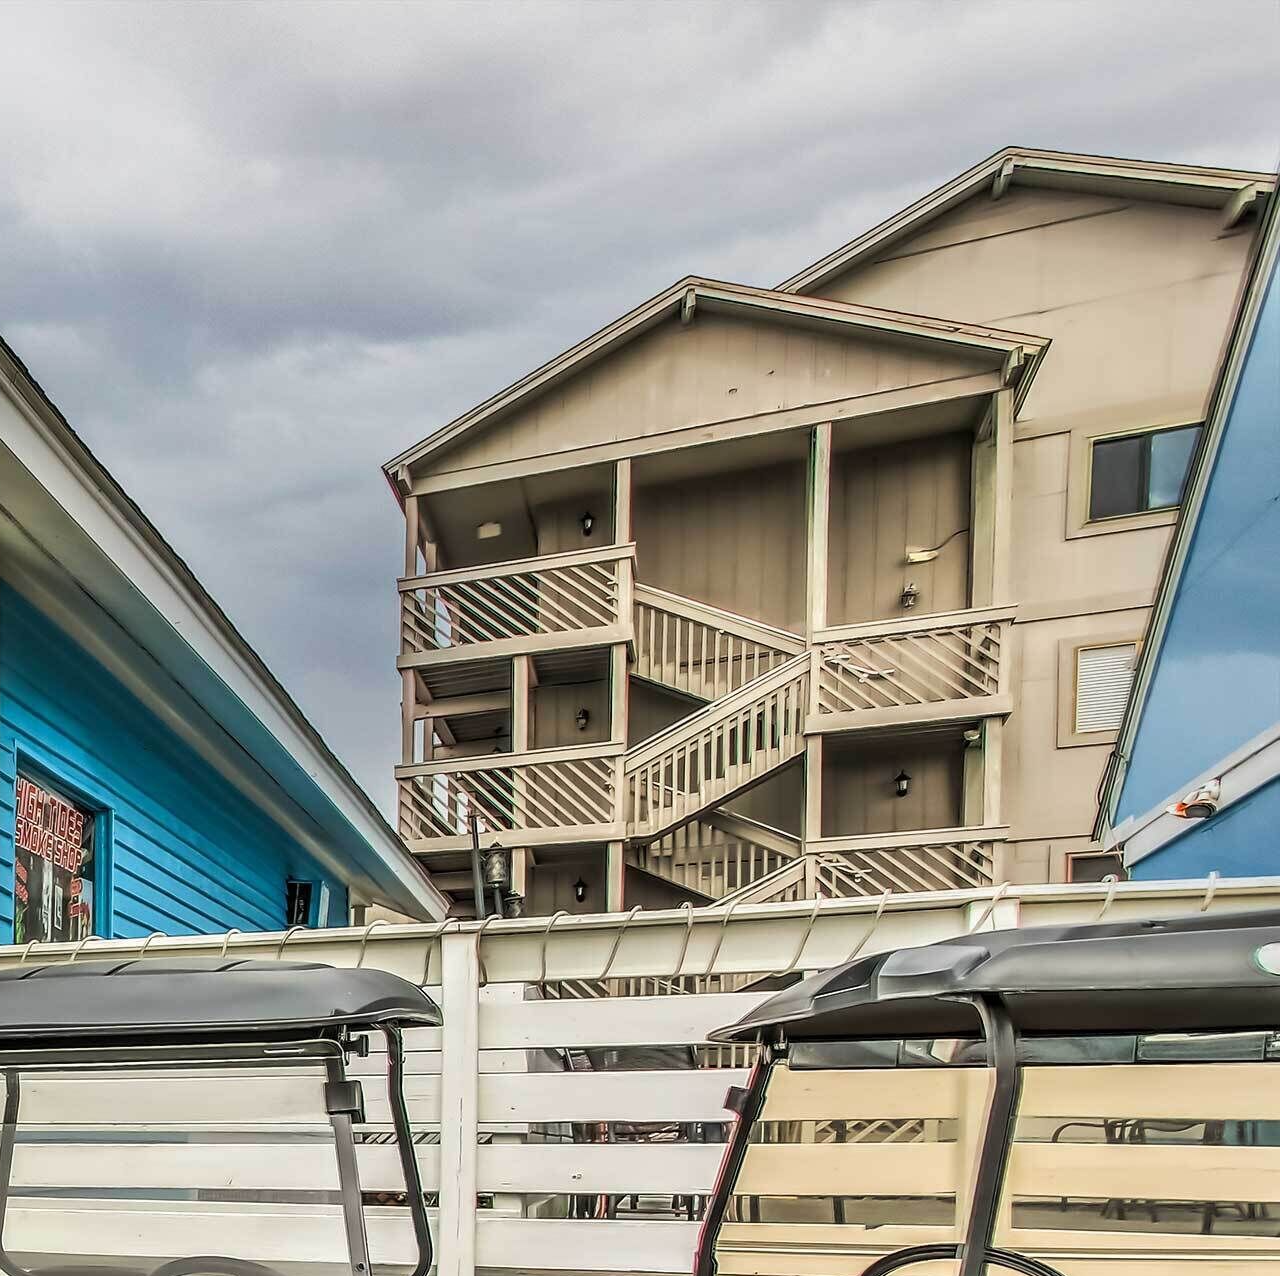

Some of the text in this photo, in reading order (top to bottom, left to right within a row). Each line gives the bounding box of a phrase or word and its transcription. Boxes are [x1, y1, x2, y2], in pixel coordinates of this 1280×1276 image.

[16, 776, 83, 848] HIGH TIDES
[16, 817, 82, 873] SMOKE SHOP
